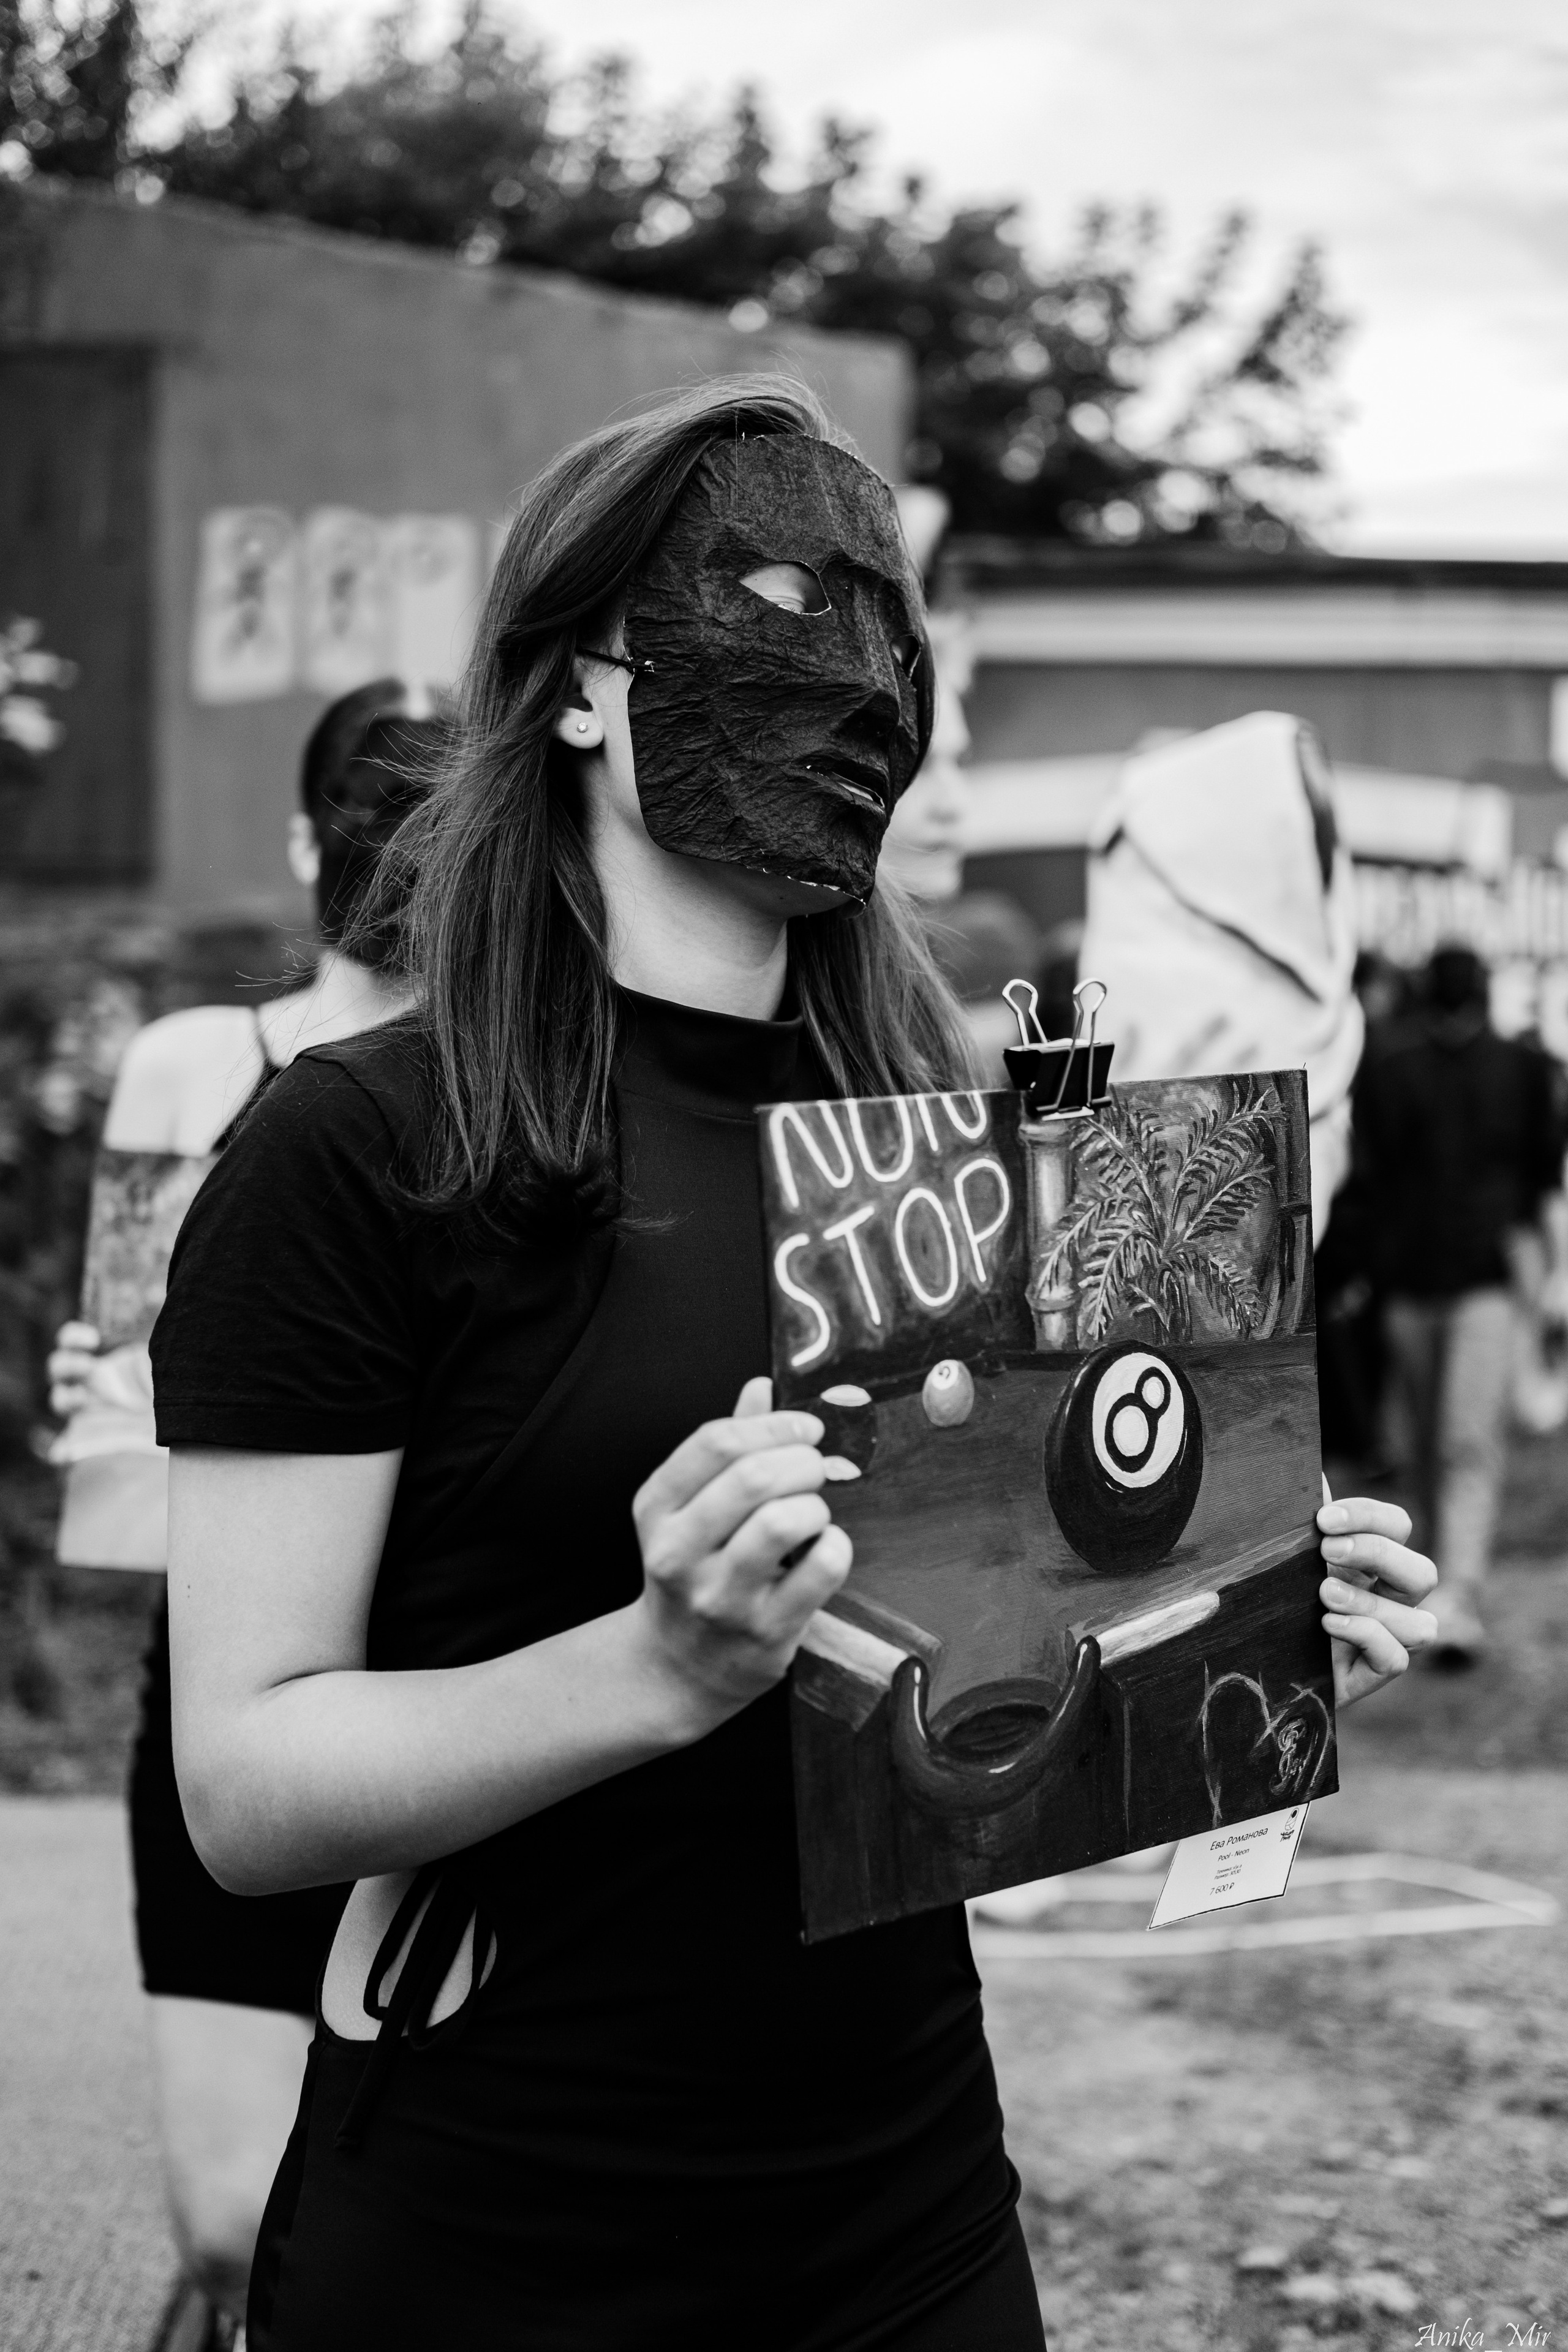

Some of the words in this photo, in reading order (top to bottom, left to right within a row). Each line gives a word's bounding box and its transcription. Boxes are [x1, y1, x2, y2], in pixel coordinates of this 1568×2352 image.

[774, 1158, 1009, 1366] STOP
[1104, 1366, 1171, 1473] 8
[1210, 1840, 1226, 1850] Ева
[1226, 1828, 1268, 1845] Романова
[1218, 1852, 1231, 1861] Pool
[1234, 1849, 1250, 1857] Neon
